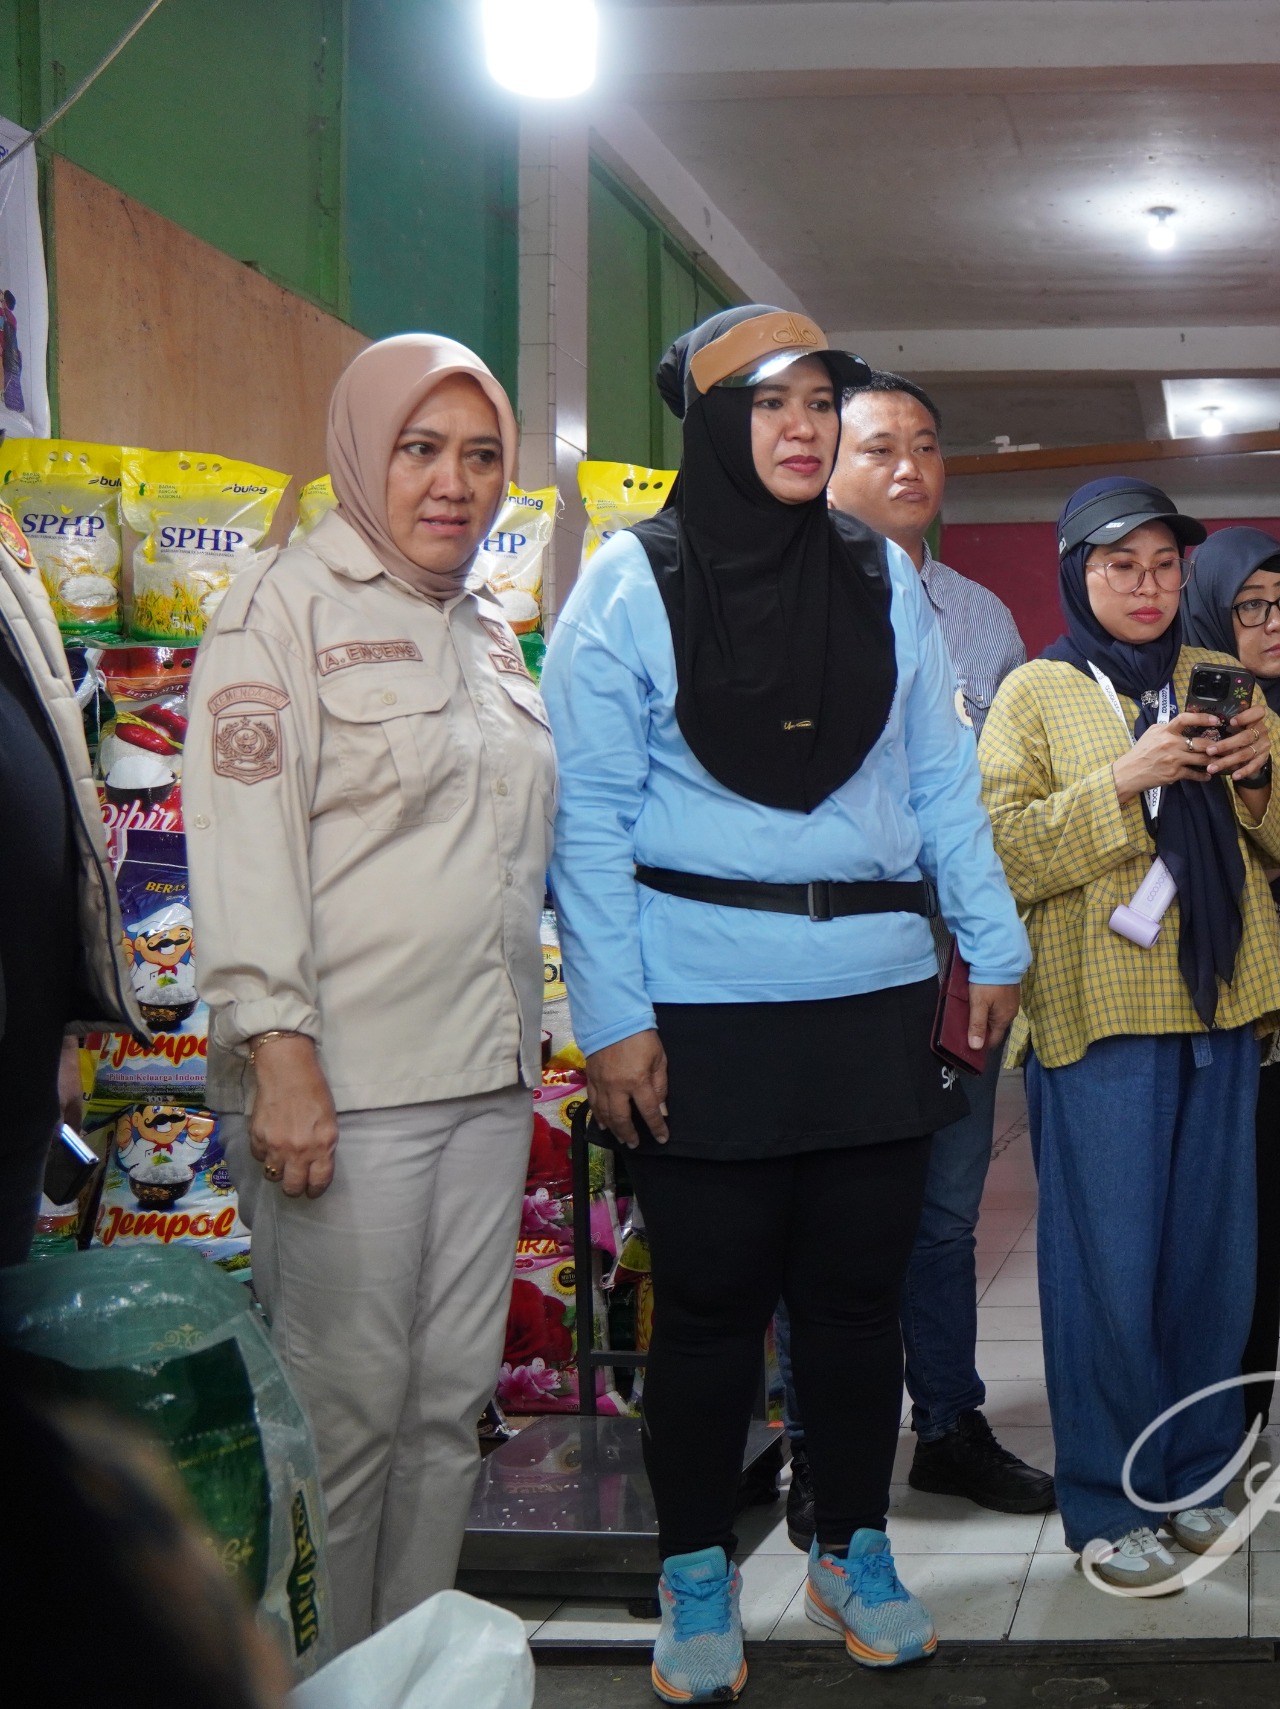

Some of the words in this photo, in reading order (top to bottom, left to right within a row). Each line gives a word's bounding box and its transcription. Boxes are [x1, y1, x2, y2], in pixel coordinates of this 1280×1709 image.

[233, 484, 268, 495] bulog
[22, 513, 105, 538] SPHP
[160, 526, 244, 553] SPHP
[483, 531, 526, 554] HP
[145, 881, 186, 894] BERAS
[136, 1073, 173, 1082] Keluarga
[175, 1073, 207, 1081] Indone
[103, 1207, 236, 1246] Jempol
